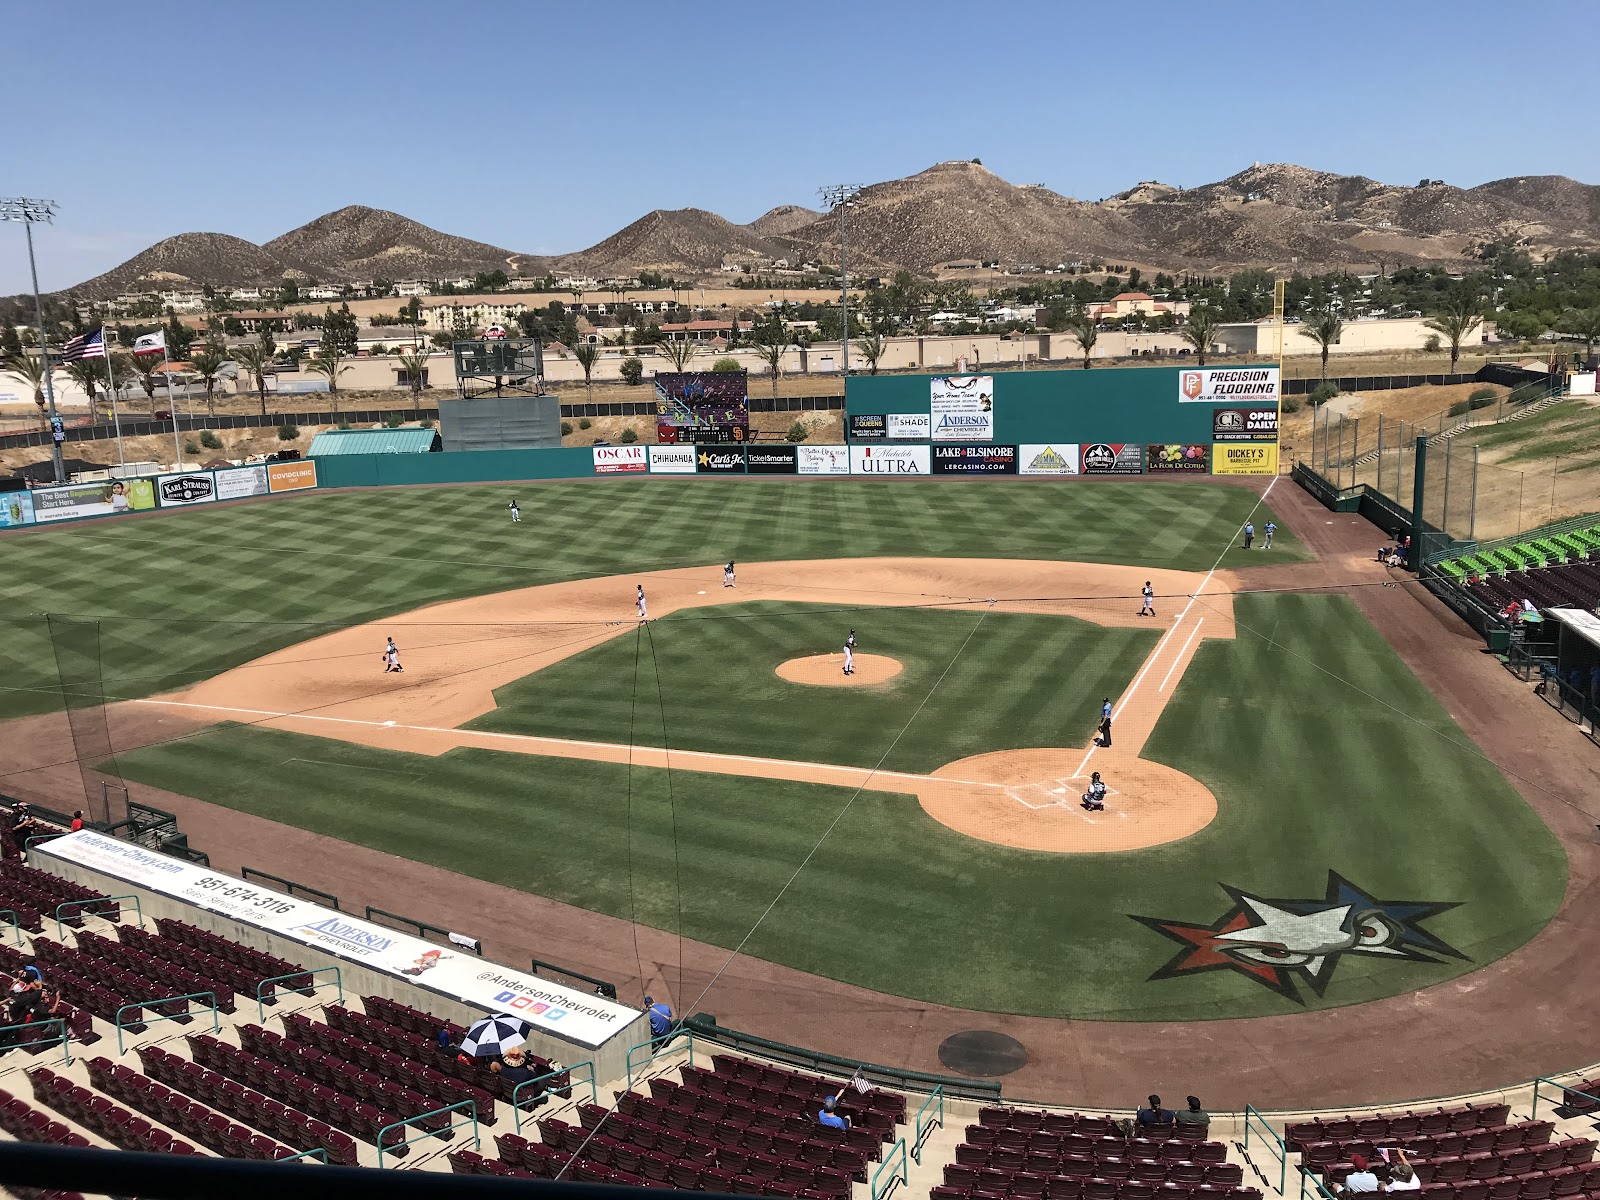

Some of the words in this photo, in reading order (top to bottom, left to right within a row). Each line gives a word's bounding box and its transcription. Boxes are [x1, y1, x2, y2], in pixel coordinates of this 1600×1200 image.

[1209, 371, 1269, 382] PRECISION
[1213, 383, 1275, 394] FLOORING
[932, 392, 944, 400] Your
[1249, 412, 1276, 420] OPEN
[934, 414, 989, 433] ANDERSON
[597, 447, 642, 459] OSCAR
[748, 454, 794, 462] TicketSmarter
[872, 448, 913, 458] Michelob
[935, 447, 960, 458] LAKE
[966, 447, 1014, 457] ELSINORE
[1227, 449, 1264, 458] DICKEY'S
[652, 454, 694, 464] CHIHUAHUA
[709, 453, 730, 464] Carl's
[862, 459, 920, 472] ULTRA
[271, 469, 312, 480] COVIDCLINIC
[164, 484, 183, 494] KARL
[183, 480, 209, 490] STRAUSS
[40, 493, 53, 501] The
[55, 491, 69, 499] Best
[70, 489, 103, 498] Beginnings
[42, 500, 58, 508] Start
[72, 833, 185, 874] Anderson-Chevy.com
[194, 877, 296, 914] 951-674-3116
[182, 888, 205, 898] Sales
[207, 896, 239, 911] Service
[241, 907, 266, 920] Parts
[286, 917, 398, 950] ANDERSON
[317, 934, 373, 956] CHEVROLET
[476, 971, 617, 1023] @AndersonChevrolet
